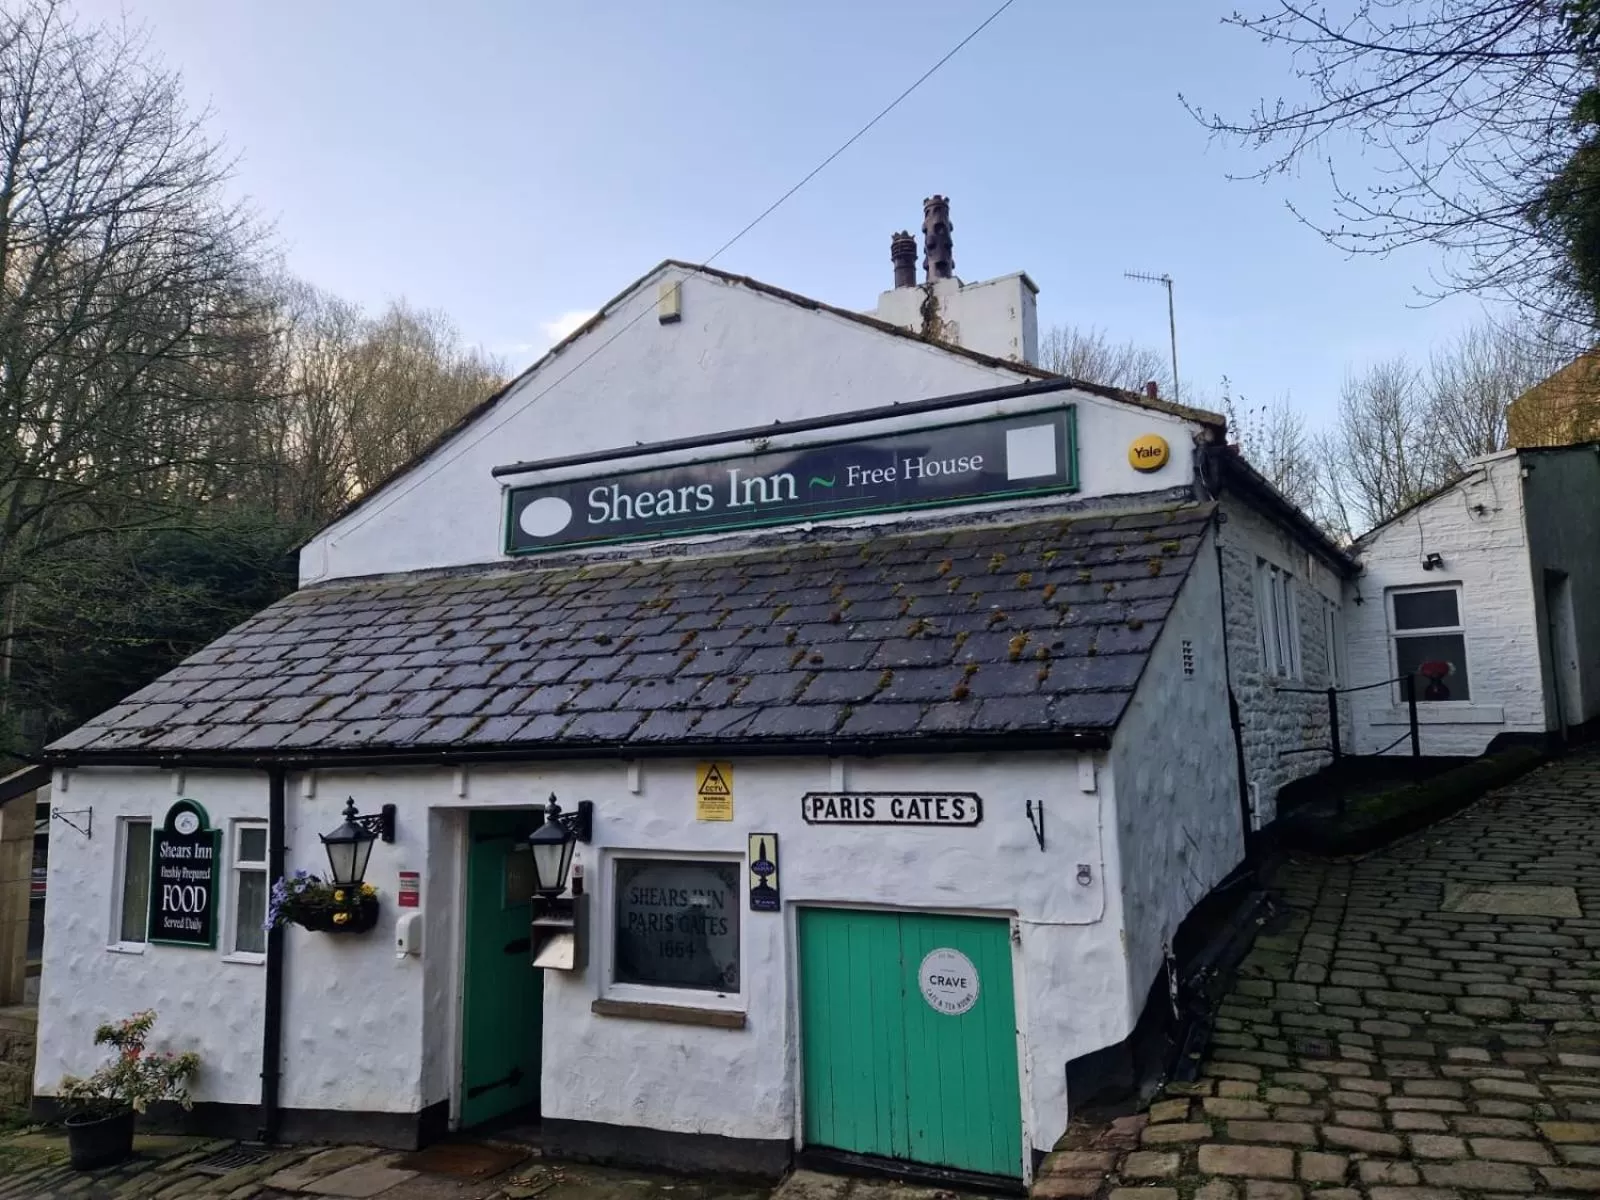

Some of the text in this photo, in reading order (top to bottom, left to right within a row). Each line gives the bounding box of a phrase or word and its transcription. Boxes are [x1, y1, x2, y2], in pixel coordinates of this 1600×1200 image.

[1133, 445, 1162, 459] Yale
[587, 454, 984, 524] Shears Inn Free House
[812, 797, 966, 820] PARIS GATES
[160, 841, 213, 859] Shears Inn
[162, 885, 207, 912] FOOD
[630, 886, 689, 907] SHEARS
[163, 916, 184, 929] Served
[628, 911, 729, 936] PARIS GATES
[929, 975, 968, 989] CRAVE
